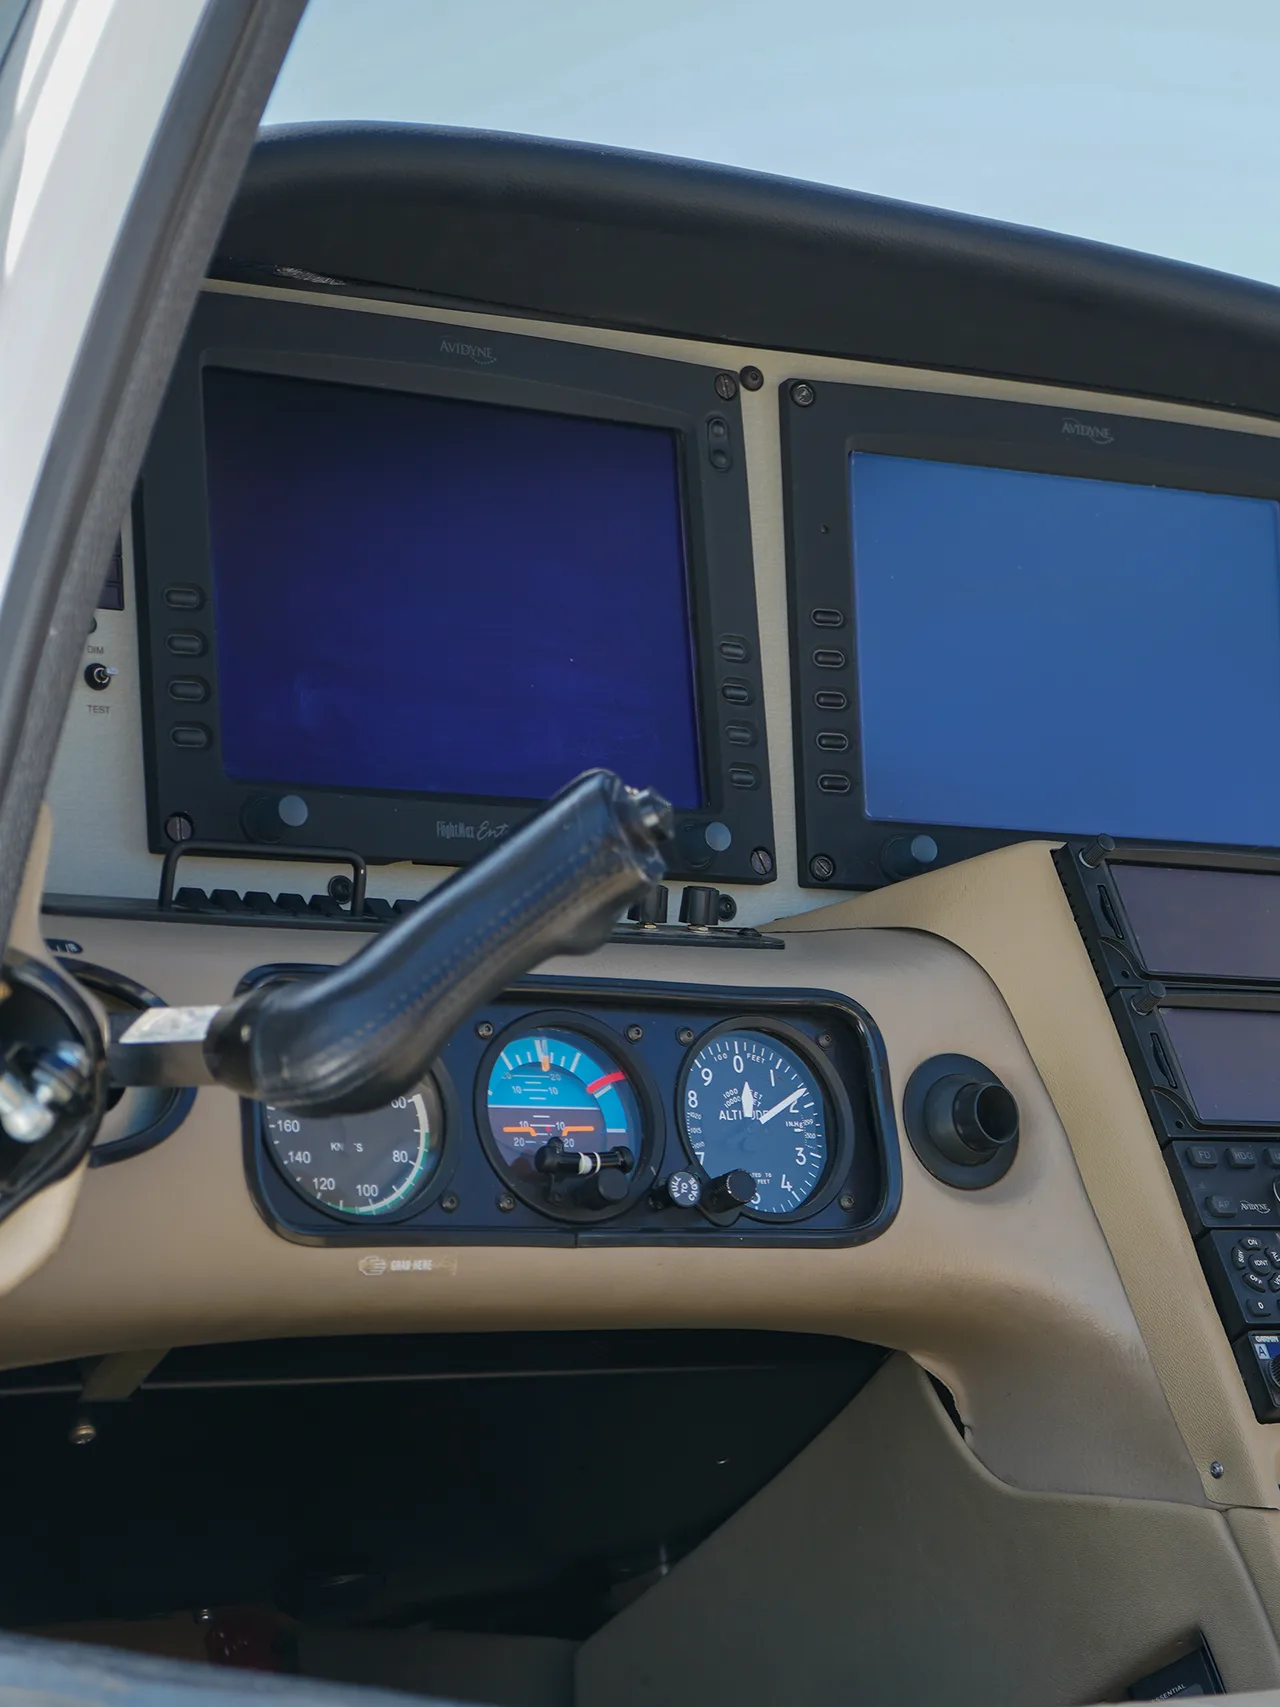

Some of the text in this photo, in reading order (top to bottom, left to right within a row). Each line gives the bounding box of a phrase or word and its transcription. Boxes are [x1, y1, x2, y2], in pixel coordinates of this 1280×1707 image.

[440, 339, 494, 359] AVIDYNE
[1061, 421, 1111, 439] AVIDYNE
[87, 645, 104, 655] DIM
[86, 704, 110, 714] TEST
[714, 1053, 765, 1064] 100 FEET
[733, 1055, 744, 1073] 0
[550, 1073, 561, 1081] 20
[701, 1068, 713, 1086] 9
[769, 1069, 775, 1087] 1
[512, 1086, 559, 1096] 10 10
[723, 1088, 739, 1099] 1000
[687, 1090, 698, 1108] 8
[277, 1120, 300, 1133] 160
[555, 1121, 566, 1131] 10
[513, 1138, 575, 1148] 20 20
[288, 1151, 311, 1164] 140
[392, 1150, 408, 1163] 80
[695, 1152, 705, 1166] 7
[795, 1147, 807, 1166] 3
[1199, 1151, 1211, 1159] FD
[1234, 1151, 1254, 1160] HDG
[312, 1178, 336, 1190] 120
[670, 1175, 682, 1198] PULL
[681, 1182, 688, 1194] TO
[781, 1174, 792, 1192] 4
[356, 1184, 379, 1197] 100
[688, 1177, 699, 1202] CAGE
[1218, 1200, 1230, 1208] AP
[1240, 1202, 1269, 1212] AVIDYNE
[1237, 1249, 1245, 1263] SBY
[1249, 1274, 1263, 1285] OFF
[1254, 1335, 1279, 1343] GARMIN
